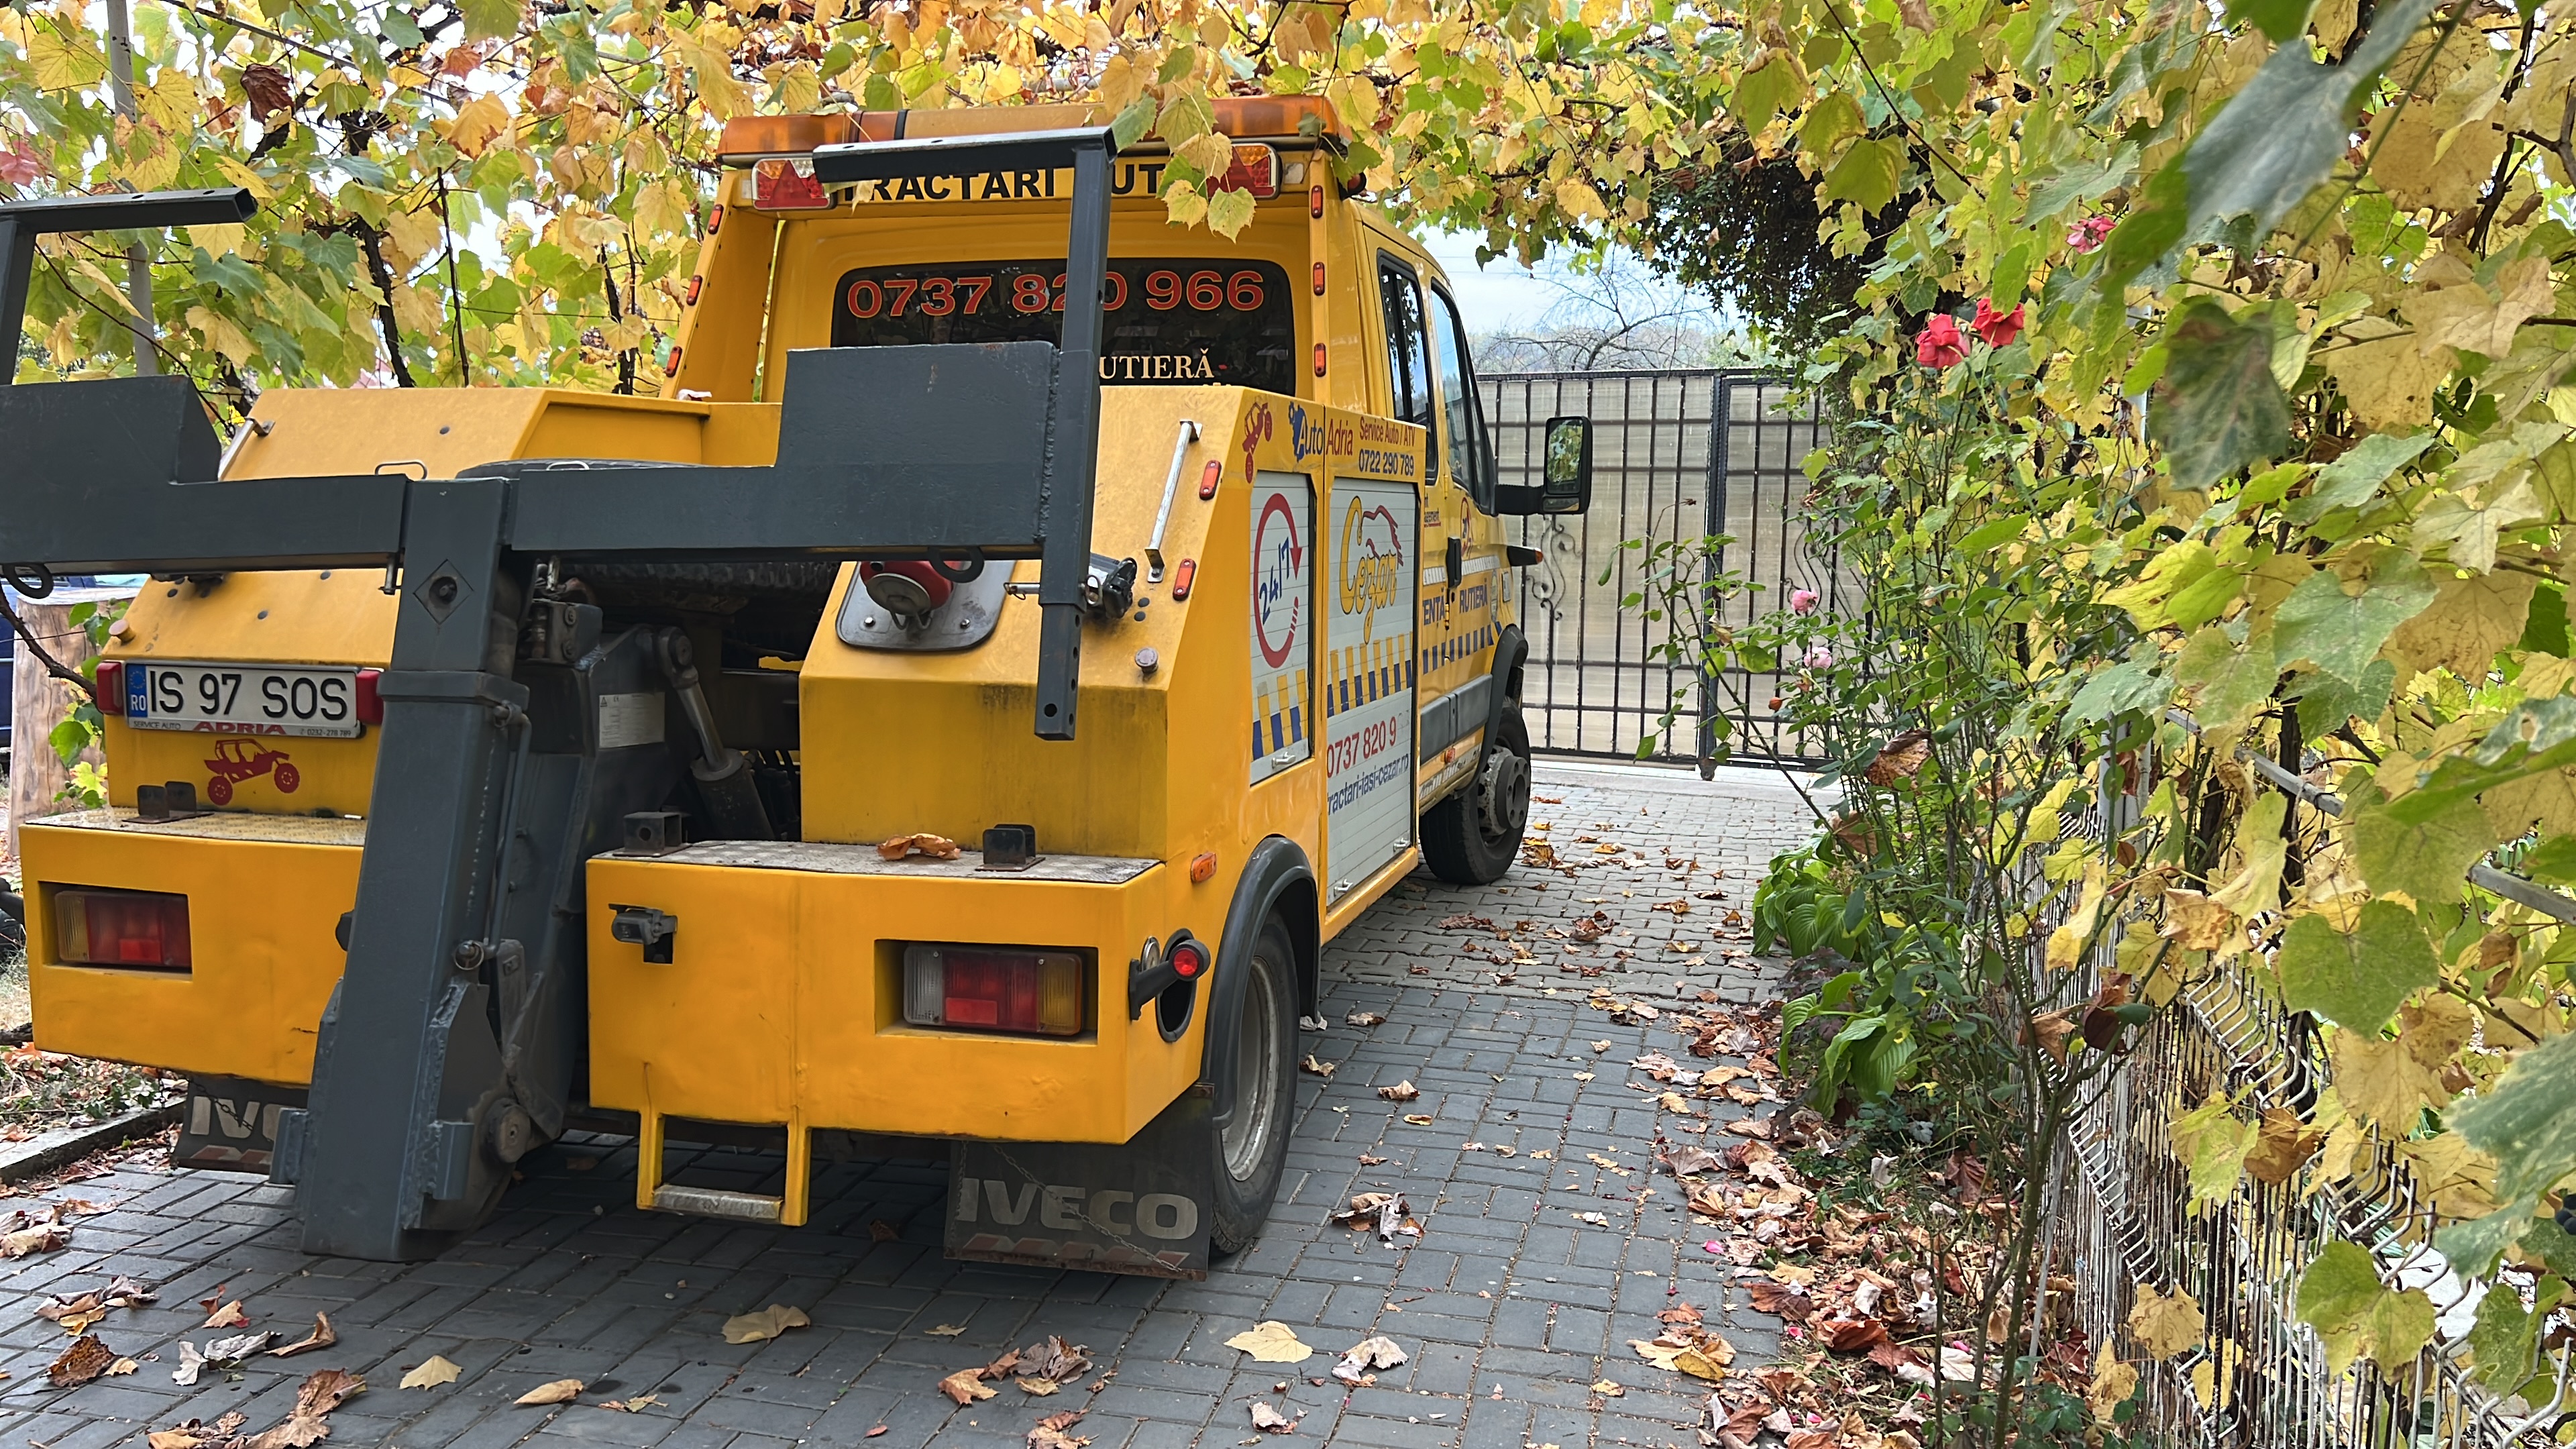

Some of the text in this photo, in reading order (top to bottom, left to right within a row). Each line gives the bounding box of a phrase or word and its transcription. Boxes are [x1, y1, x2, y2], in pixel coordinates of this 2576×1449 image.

[847, 276, 993, 319] 0737
[1145, 270, 1265, 311] 966
[1098, 347, 1215, 380] UTIERĂ
[1297, 417, 1354, 456] Auto Adria
[1359, 415, 1384, 443] Service
[1385, 422, 1399, 444] Auto
[1403, 426, 1416, 447] ATV
[1358, 448, 1414, 476] 0722 290 789
[1259, 537, 1289, 627] 24/7
[1340, 495, 1397, 644] Cezar
[1423, 586, 1446, 629] ENȚĂ
[131, 671, 347, 720] RO IS 97 SOS
[133, 720, 159, 729] SERVICE
[162, 722, 181, 731] AUTO
[192, 721, 287, 735] ADRIA
[1327, 732, 1360, 778] 0737
[1363, 720, 1386, 759] 820
[1328, 753, 1409, 815] ractari-iasi-cezar.ro
[956, 1177, 1198, 1240] IVECO
